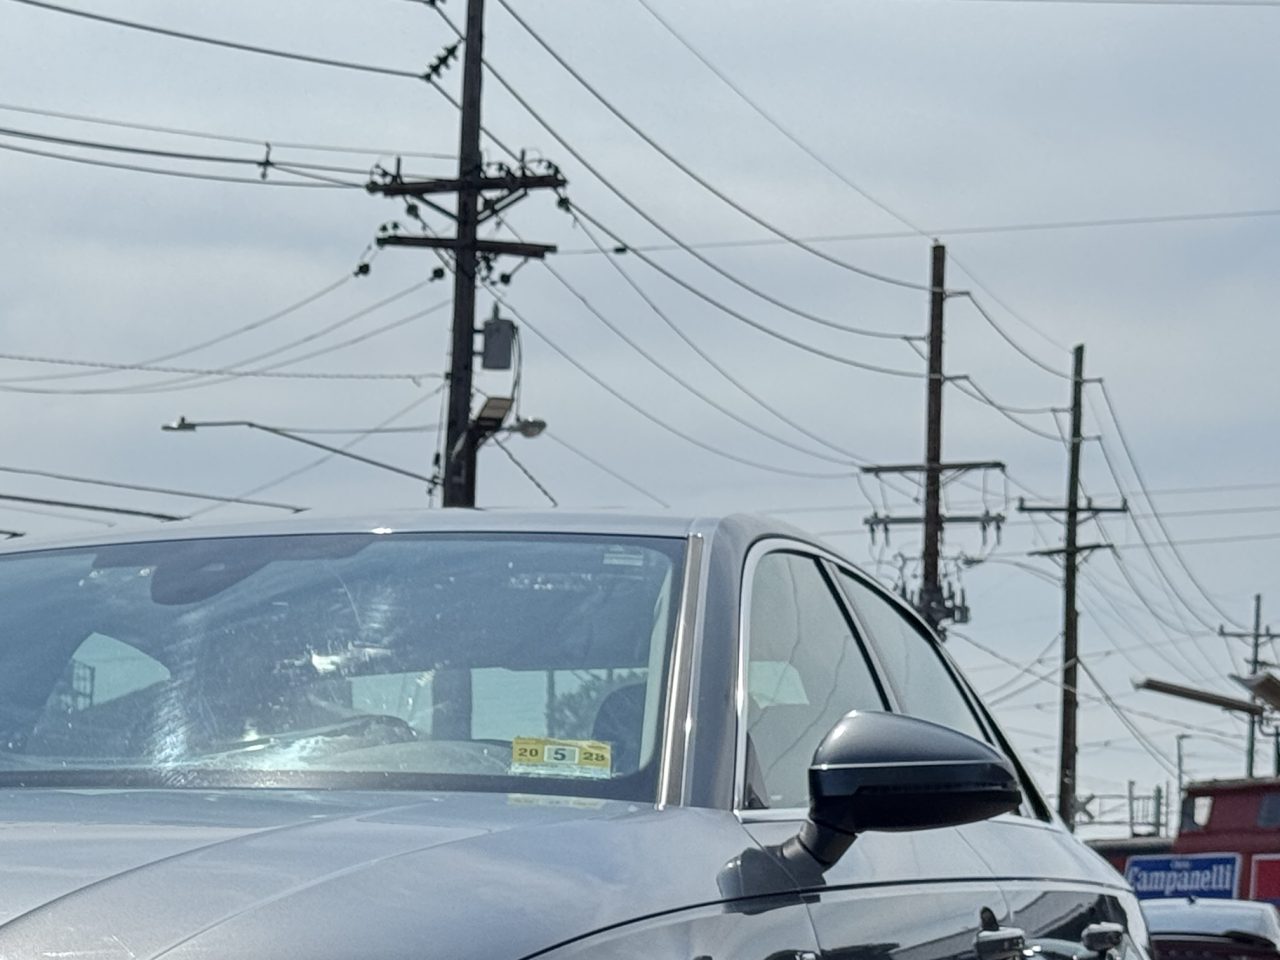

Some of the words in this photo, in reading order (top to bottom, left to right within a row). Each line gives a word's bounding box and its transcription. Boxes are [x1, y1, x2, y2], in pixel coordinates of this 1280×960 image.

[518, 748, 539, 758] 20
[553, 748, 567, 761] 5
[1128, 863, 1232, 896] Campanelli
